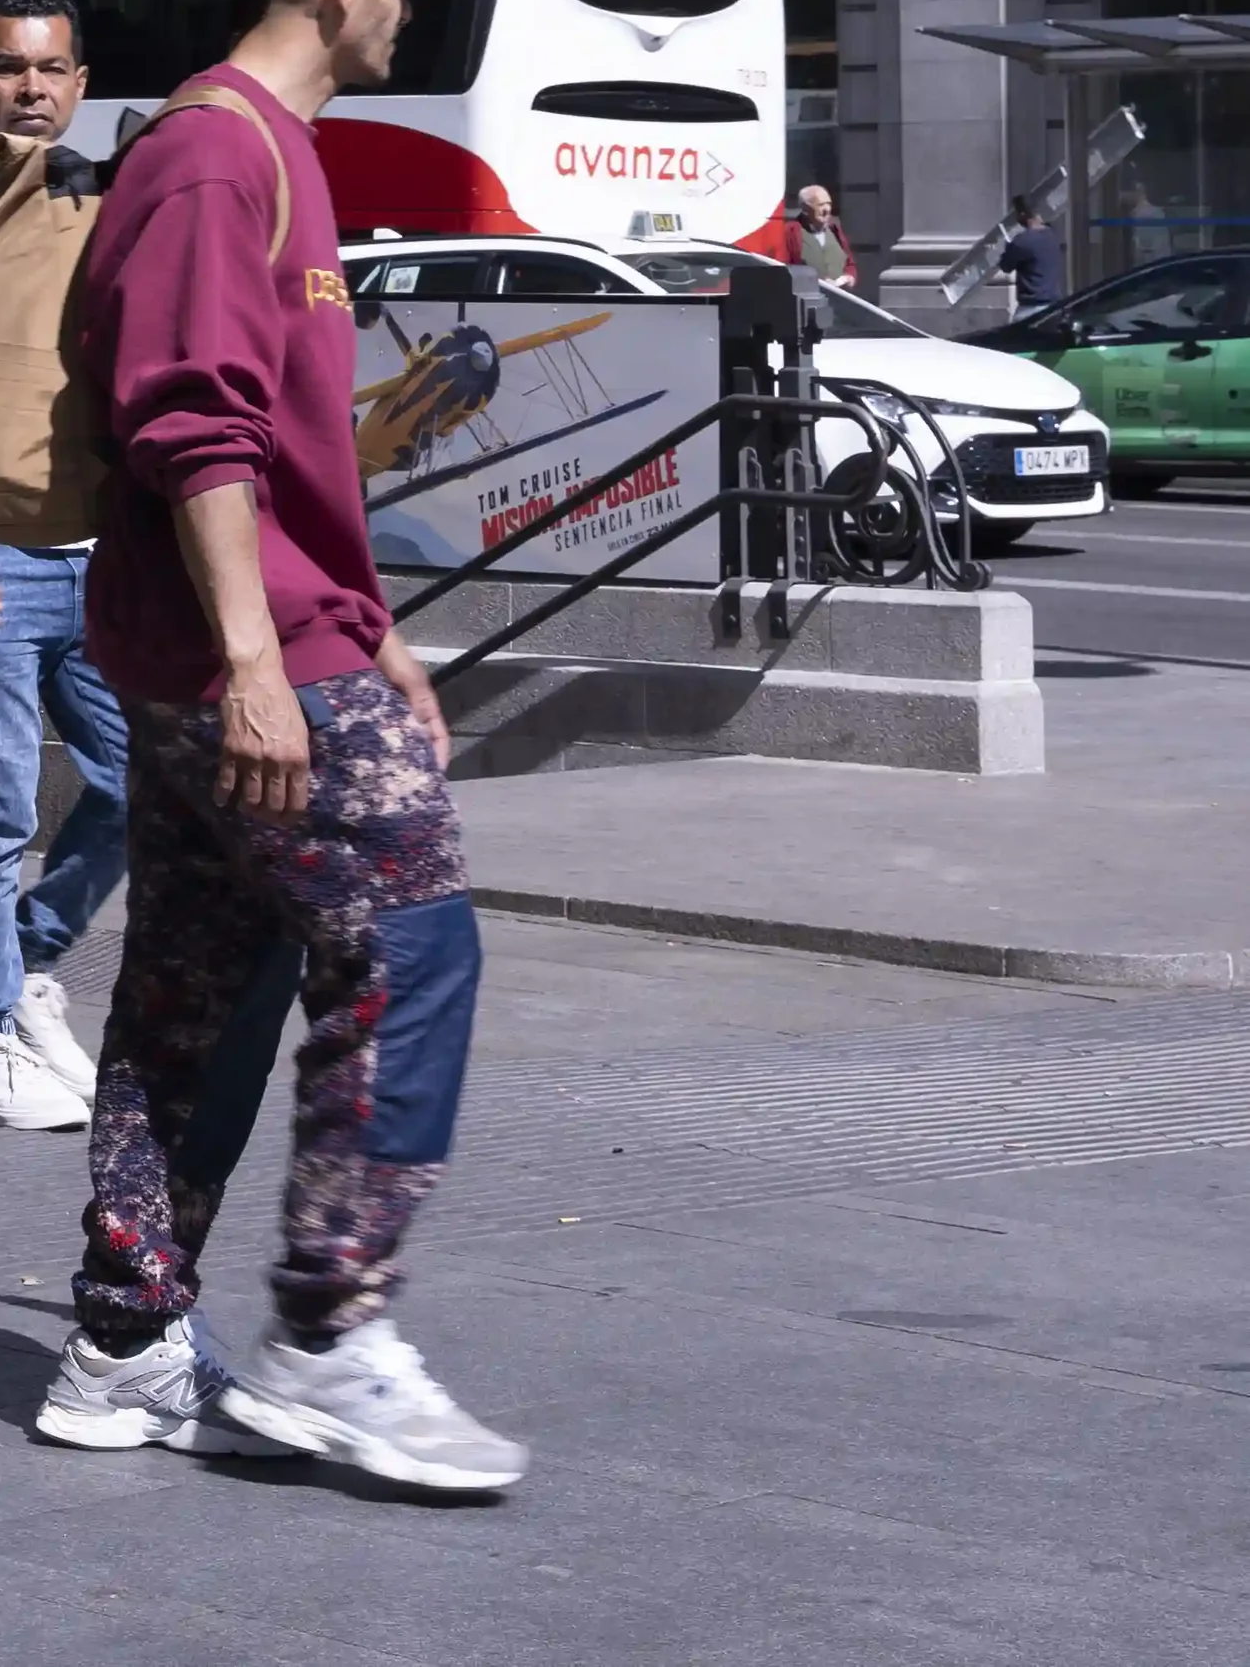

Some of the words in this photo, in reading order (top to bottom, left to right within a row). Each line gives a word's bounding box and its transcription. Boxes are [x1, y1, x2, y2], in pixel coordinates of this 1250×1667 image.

[555, 142, 699, 181] avanza
[478, 484, 509, 514] TOM
[520, 457, 582, 498] CRUISE
[555, 507, 632, 552] SENTENCIA
[640, 489, 682, 522] FINAL
